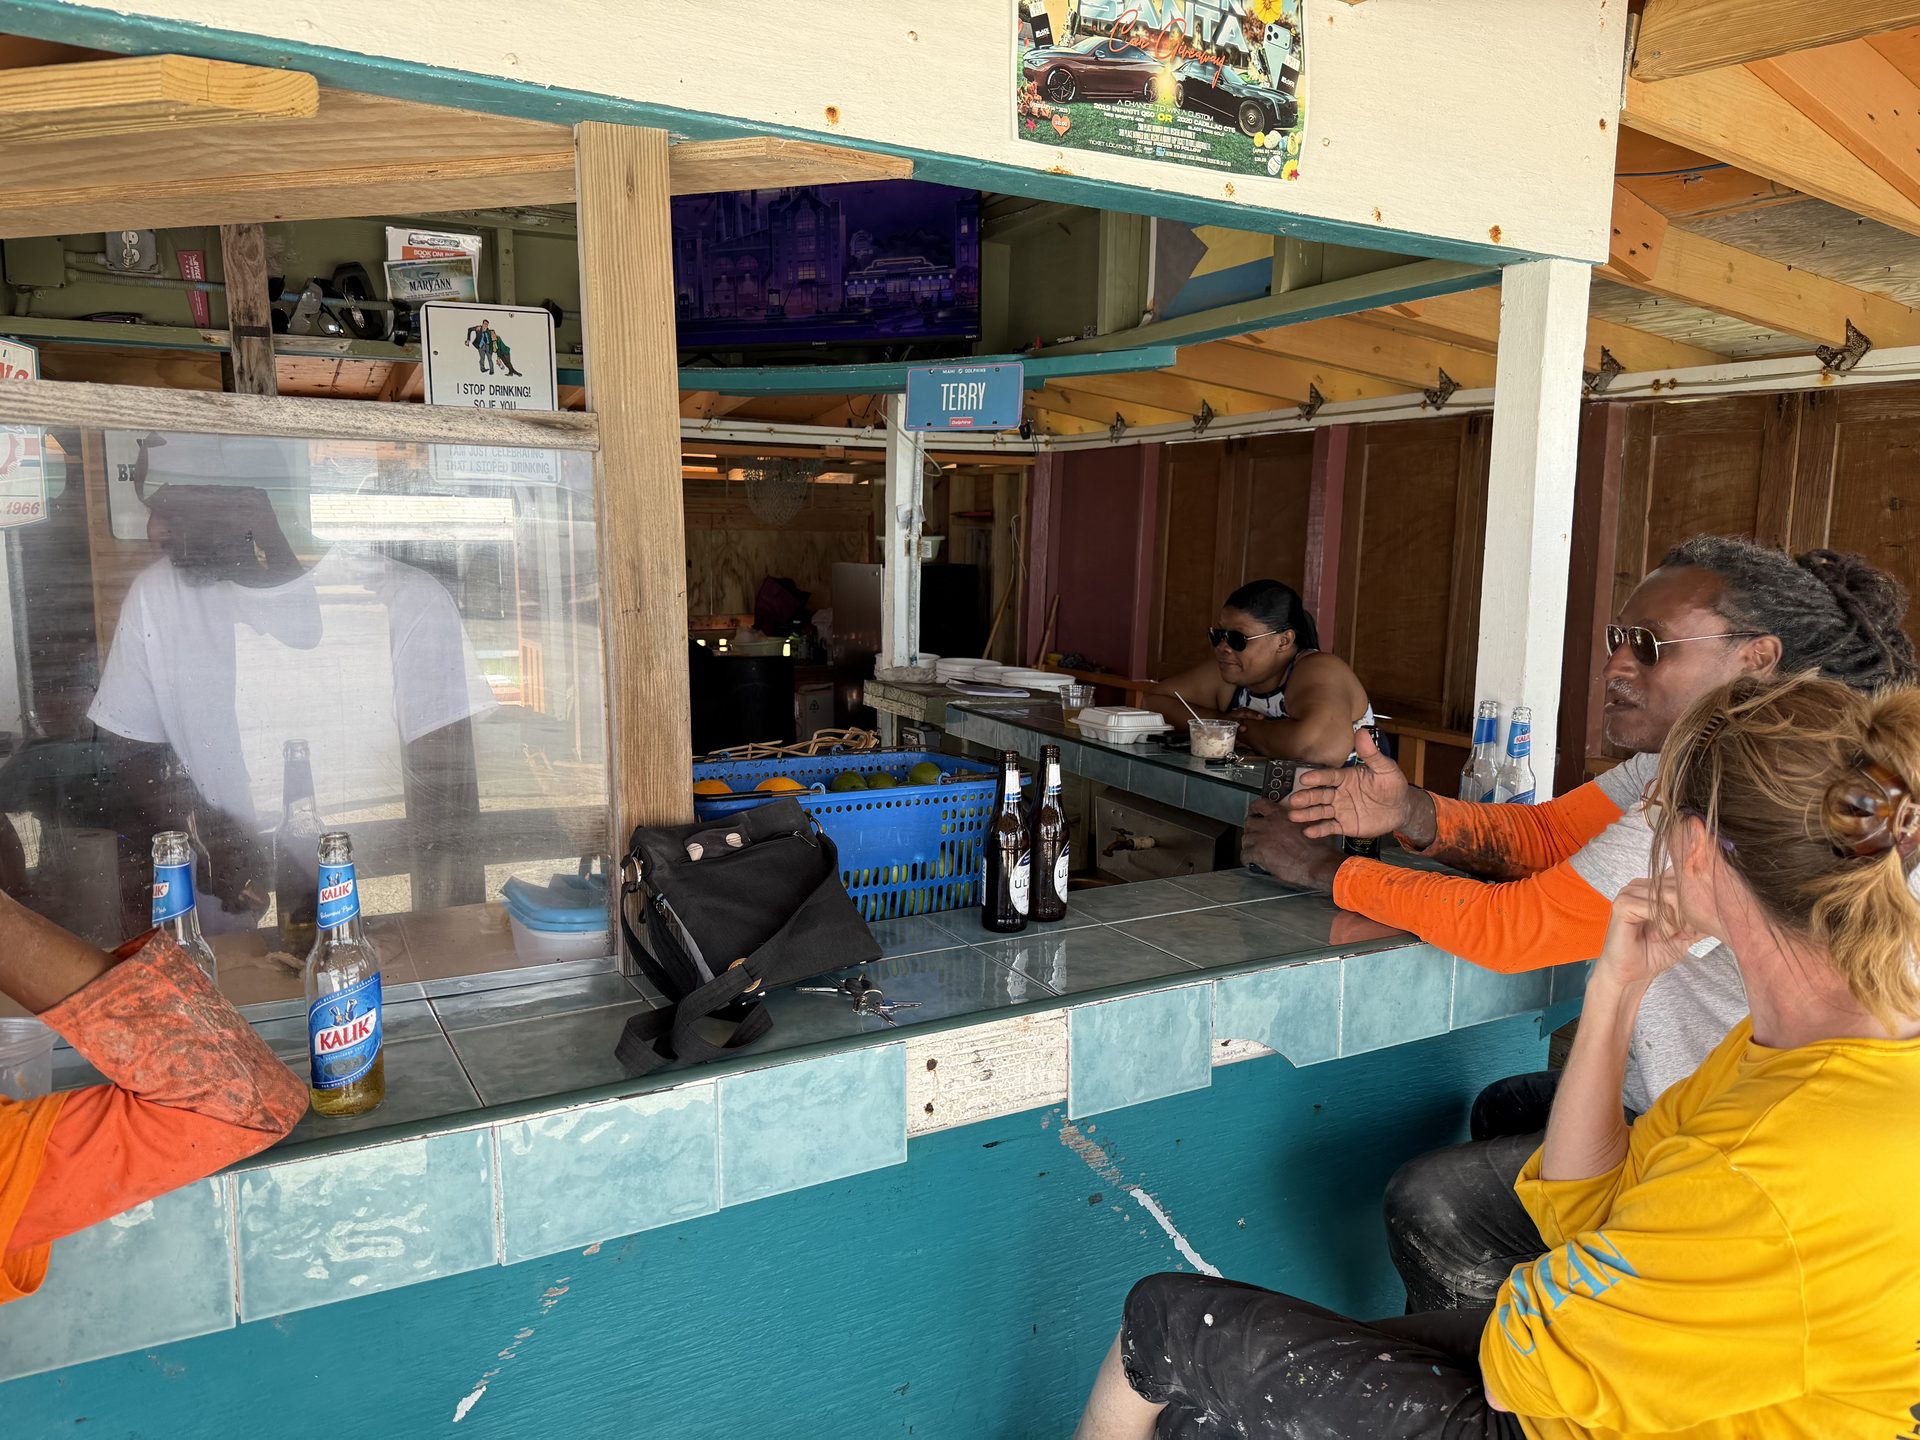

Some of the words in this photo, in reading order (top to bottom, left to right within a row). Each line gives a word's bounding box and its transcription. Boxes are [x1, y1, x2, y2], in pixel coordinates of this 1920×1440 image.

[1109, 9, 1150, 52] Car
[1155, 18, 1226, 88] Giveaway
[1093, 102, 1111, 111] 2019
[1112, 105, 1140, 116] INFINITI
[1124, 100, 1153, 109] CHANCE
[1155, 104, 1166, 112] TO
[1188, 111, 1214, 122] CUSTOM
[1157, 113, 1173, 123] OR
[1177, 115, 1193, 124] 2020
[1194, 118, 1223, 131] CADILLAC
[413, 249, 431, 257] BOOK
[456, 383, 460, 394] I
[463, 383, 485, 395] STOP
[489, 384, 531, 398] DRINKING!
[941, 382, 986, 411] TERRY
[473, 399, 486, 408] SO
[499, 401, 517, 410] YOU
[453, 446, 466, 457] AM
[469, 446, 488, 457] JUST
[492, 447, 544, 459] CELEBRATING
[445, 460, 465, 471] THAT
[476, 461, 508, 473] STOPED
[511, 463, 550, 474] DRINKING
[7, 502, 40, 515] 1966
[321, 881, 351, 903] KALIK
[319, 1019, 371, 1051] KALIK
